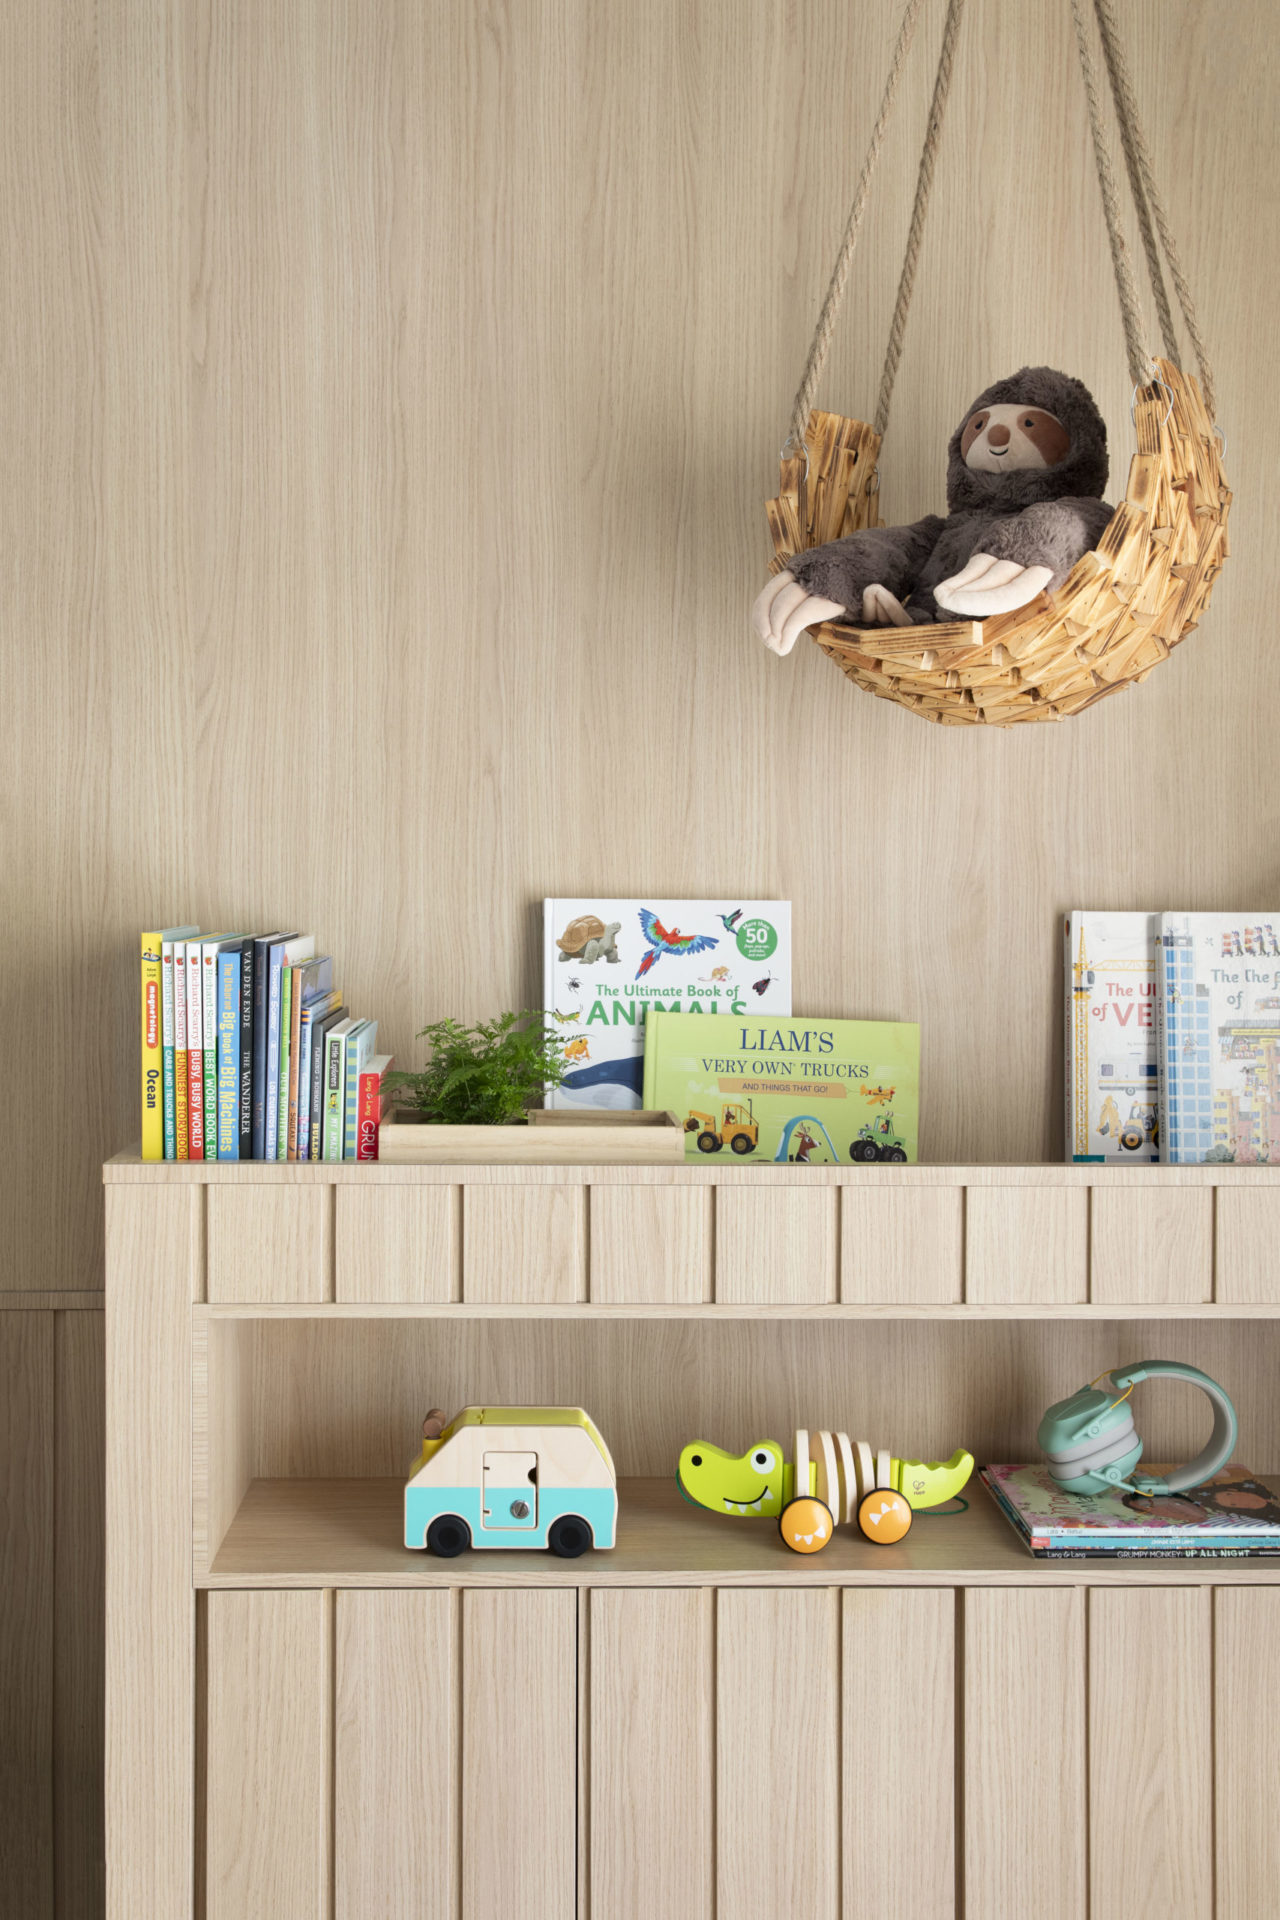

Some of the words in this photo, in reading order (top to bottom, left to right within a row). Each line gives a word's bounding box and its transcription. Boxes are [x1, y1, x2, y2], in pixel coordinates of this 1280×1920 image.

[746, 928, 768, 944] 50
[224, 963, 234, 975] The
[244, 951, 252, 973] VAN
[164, 966, 173, 1005] Richard
[177, 968, 186, 1007] Richard
[192, 967, 200, 1006] Richard
[206, 967, 214, 1007] Richard
[243, 975, 251, 997] DEN
[1210, 968, 1239, 983] The
[224, 978, 234, 1010] Usborne
[595, 984, 620, 997] The
[624, 984, 682, 997] Ultimate
[687, 984, 721, 997] Book
[725, 984, 741, 1002] of
[1105, 983, 1133, 997] The
[1227, 991, 1244, 1010] of
[148, 985, 157, 1044] magnetology
[220, 1011, 237, 1030] Big
[243, 1000, 251, 1028] ENDE
[1092, 1003, 1109, 1022] of
[1112, 1003, 1153, 1027] VE
[176, 1009, 186, 1047] Scarry's
[191, 1009, 200, 1047] Scarry's
[205, 1010, 214, 1047] Scarry's
[222, 1032, 235, 1054] book
[331, 1042, 340, 1058] Little
[739, 1028, 834, 1053] LIAM'S
[165, 1050, 173, 1069] CARS
[190, 1051, 201, 1079] BUSY,
[205, 1051, 215, 1075] BEST
[224, 1056, 233, 1064] of
[243, 1050, 251, 1068] THE
[702, 1058, 747, 1074] VERY
[752, 1061, 794, 1075] OWN
[800, 1062, 869, 1079] TRUCKS
[166, 1071, 174, 1086] AND
[177, 1052, 187, 1097] FUNNIEST
[220, 1067, 237, 1087] Big
[330, 1059, 340, 1087] Explorers
[364, 1077, 375, 1092] Lang
[147, 1070, 160, 1108] Ocean
[191, 1082, 201, 1109] BUSY
[206, 1078, 215, 1110] WORD
[742, 1083, 759, 1091] AND
[761, 1084, 791, 1093] THINGS
[792, 1085, 812, 1093] THAT
[814, 1086, 829, 1094] GO!
[166, 1089, 174, 1118] TRUCKS
[241, 1070, 251, 1135] WANDERER
[364, 1100, 374, 1116] Lang
[192, 1112, 202, 1148] WORLD
[207, 1113, 216, 1142] BOOK
[219, 1090, 237, 1152] Machines
[330, 1118, 338, 1129] MY
[1047, 1550, 1062, 1559] Lang
[1071, 1550, 1086, 1559] Lang
[1117, 1550, 1149, 1558] GRUMPY
[1185, 1549, 1198, 1557] UP
[1200, 1549, 1218, 1557] ALL
[1220, 1549, 1251, 1557] NIGHT
